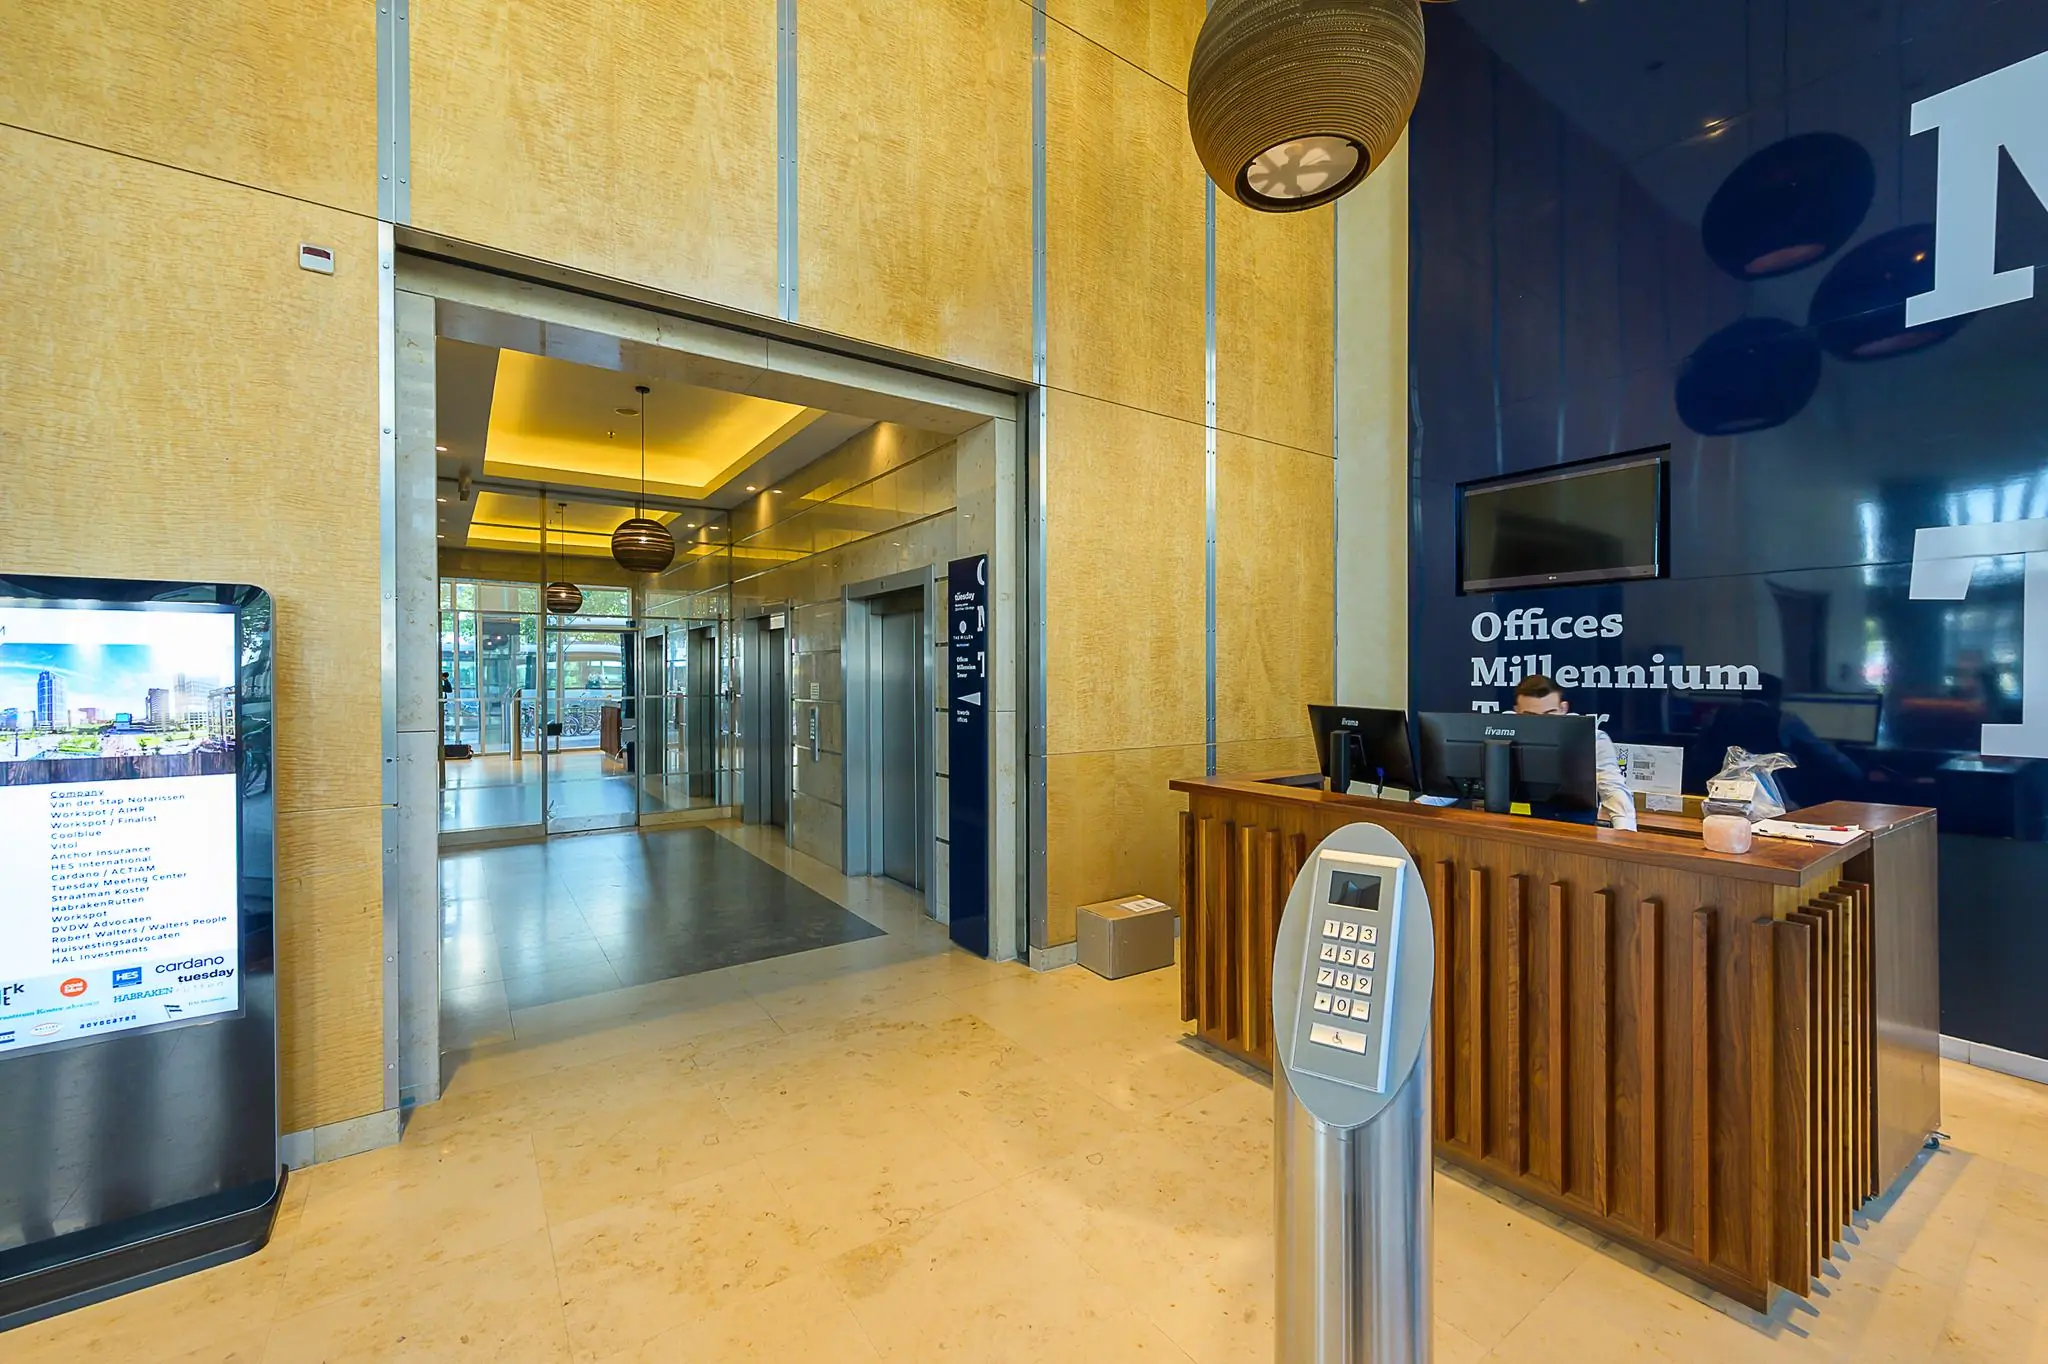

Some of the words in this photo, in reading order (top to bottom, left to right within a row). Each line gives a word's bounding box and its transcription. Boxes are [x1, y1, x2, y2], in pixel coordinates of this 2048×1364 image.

[1471, 607, 1624, 642] Offices
[1471, 653, 1762, 691] Millennium
[1484, 726, 1516, 737] iiyama
[50, 790, 104, 800] Company
[100, 798, 124, 806] Stap
[128, 794, 185, 803] Notarissen
[51, 809, 106, 819] Workspot
[118, 806, 145, 814] AIHR
[51, 819, 106, 829] Workspot
[118, 815, 157, 824] Finalist
[51, 830, 102, 840] Coolblue
[51, 842, 78, 850] Vitol
[51, 851, 92, 860] Anchor
[97, 847, 151, 857] Insurance
[51, 863, 74, 871] HES
[79, 856, 152, 868] International
[52, 871, 99, 881] Cardano
[112, 865, 156, 875] ACTIAM
[52, 881, 99, 892] Tuesday
[103, 876, 148, 887] Meeting
[152, 872, 187, 881] Center
[52, 891, 111, 902] Straatman
[115, 886, 150, 895] Koster
[52, 896, 144, 912] HabrakenRutten
[52, 911, 107, 923] Workspot
[52, 923, 89, 934] DVDW
[93, 915, 152, 928] Advocaten
[52, 932, 91, 944] Robert
[95, 925, 138, 939] Walters
[149, 920, 190, 931] Walters
[193, 915, 227, 925] People
[1328, 923, 1334, 934] 1
[1346, 926, 1355, 937] 2
[1364, 929, 1373, 941] 3
[52, 931, 181, 954] Huisvestingsadvocaten
[52, 955, 76, 964] HAL
[80, 946, 149, 961] Investments
[1324, 948, 1333, 959] 4
[1342, 950, 1352, 961] 5
[1361, 953, 1370, 965] 6
[155, 956, 225, 974] cardano
[116, 971, 139, 982] HES
[177, 968, 235, 983] tuesday
[1321, 971, 1331, 982] 7
[1340, 974, 1349, 986] 8
[1359, 978, 1368, 990] 9
[113, 987, 174, 1003] HABRAKEN
[1337, 1000, 1346, 1011] 0
